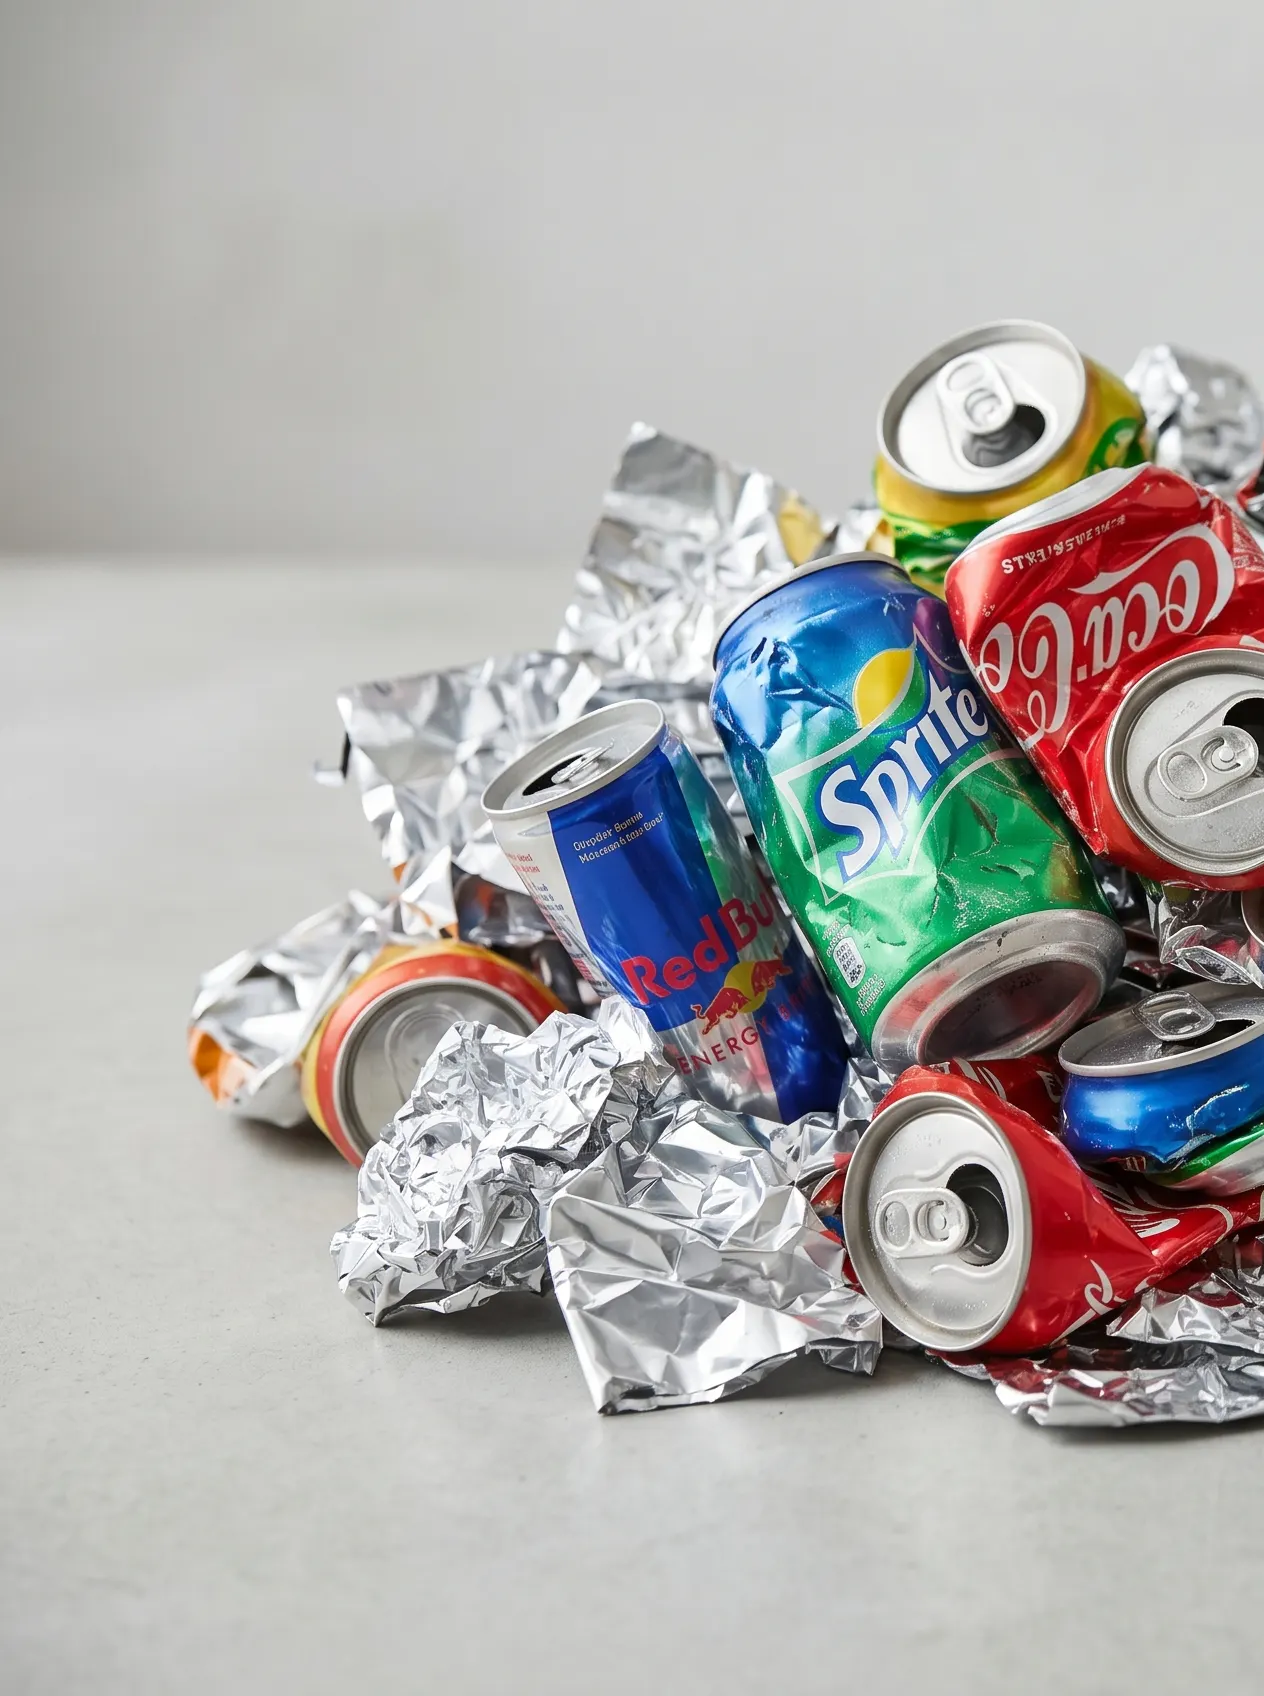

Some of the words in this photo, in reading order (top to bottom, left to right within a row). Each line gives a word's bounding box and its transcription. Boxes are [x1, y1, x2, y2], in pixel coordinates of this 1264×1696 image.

[962, 523, 1236, 748] Coca-Co
[818, 671, 990, 879] Sprite
[621, 926, 730, 1006] Red
[718, 888, 776, 953] Bu
[676, 1020, 773, 1076] ENERGY
